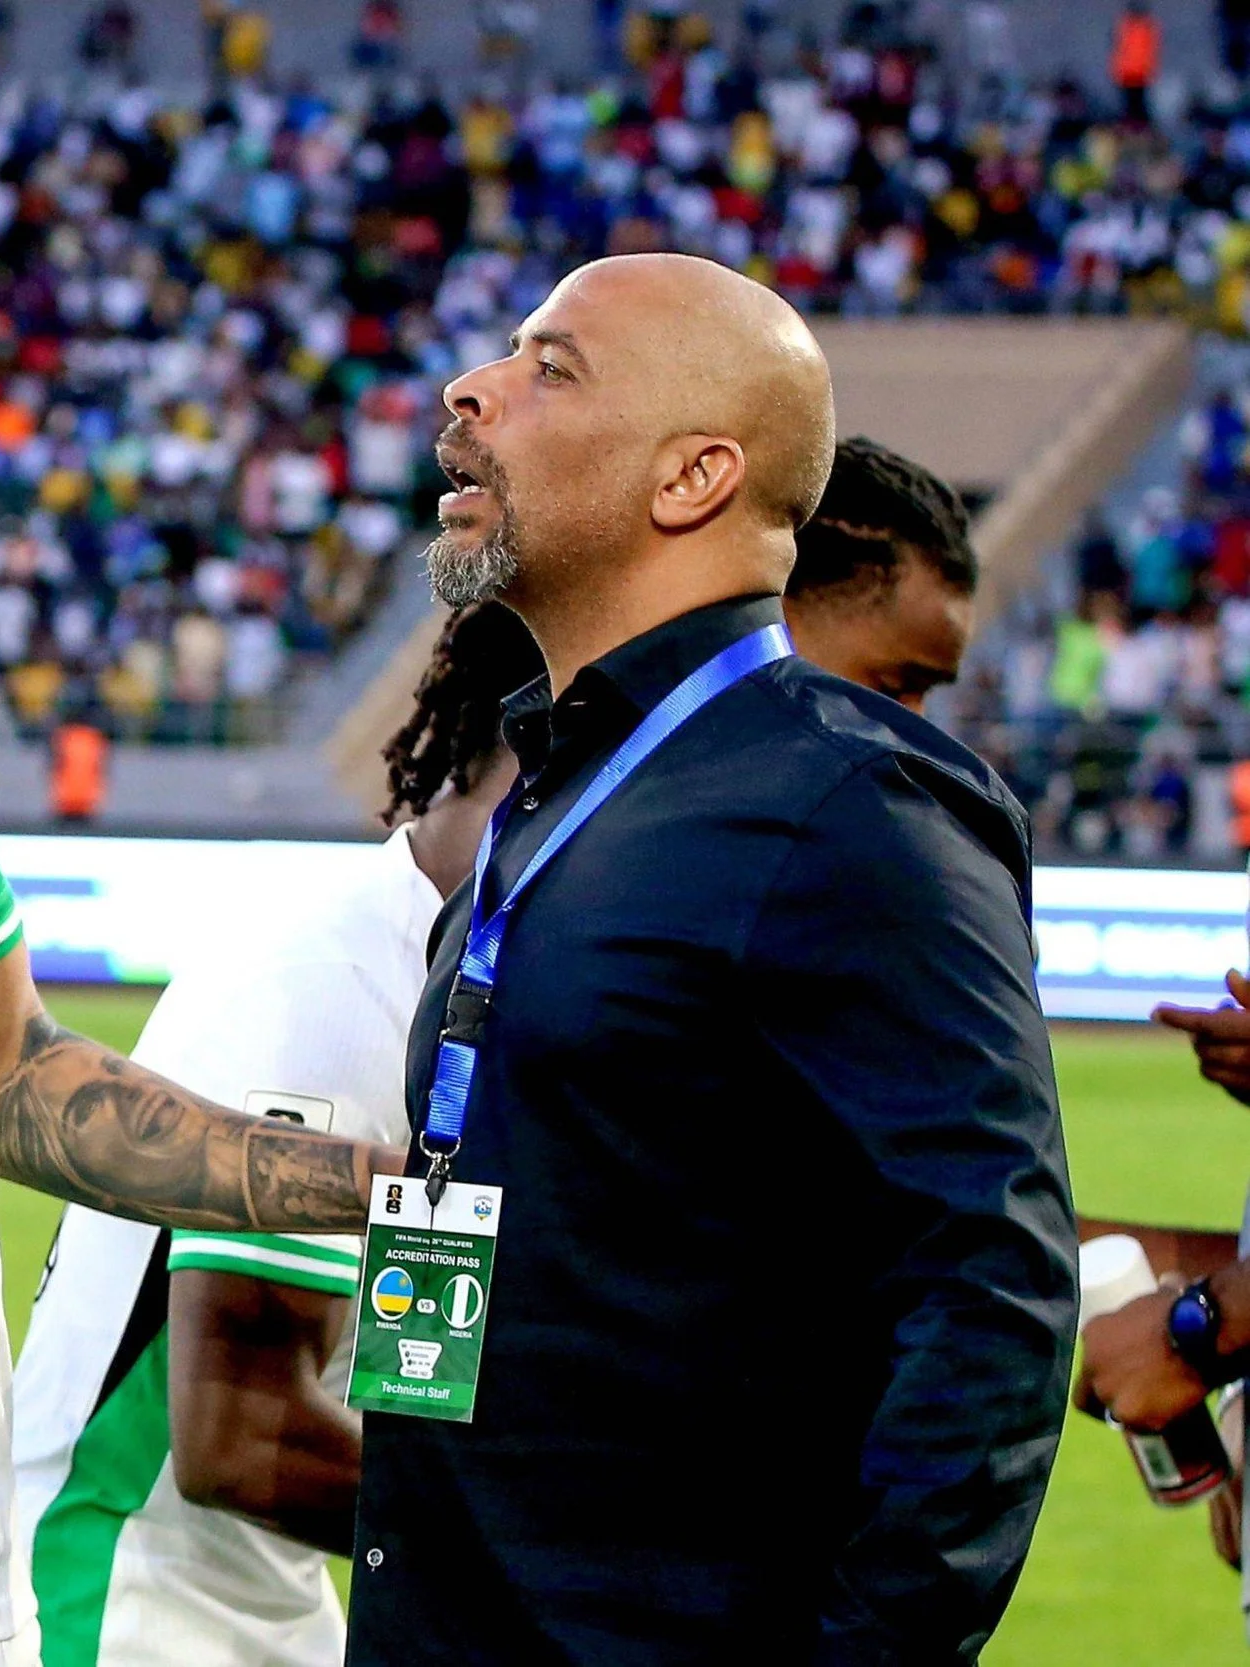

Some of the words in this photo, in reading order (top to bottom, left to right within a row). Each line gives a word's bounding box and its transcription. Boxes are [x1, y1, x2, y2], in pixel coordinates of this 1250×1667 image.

[385, 1249, 455, 1266] ACCREDITATION
[456, 1256, 481, 1269] PASS
[420, 1301, 431, 1309] VS
[382, 1381, 426, 1397] Technical
[427, 1387, 451, 1400] Staff
